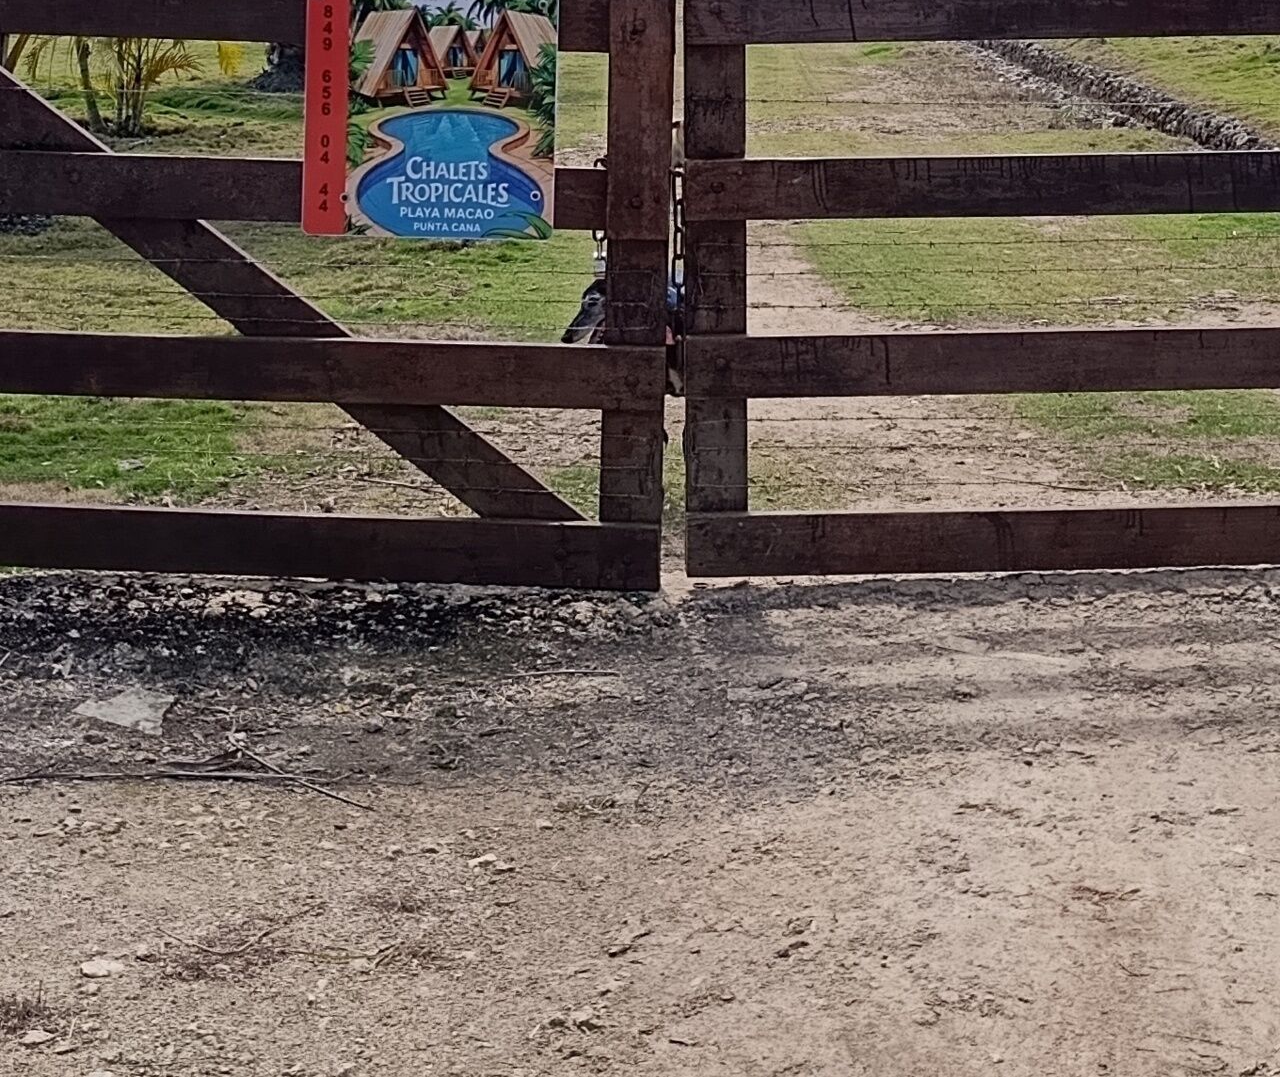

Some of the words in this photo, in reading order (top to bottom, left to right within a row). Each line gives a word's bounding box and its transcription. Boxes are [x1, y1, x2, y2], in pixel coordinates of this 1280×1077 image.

[322, 4, 334, 52] 849
[321, 70, 332, 116] 656
[319, 134, 330, 165] 04
[406, 156, 488, 180] CHALETS
[318, 182, 329, 213] 44
[386, 176, 510, 207] TROPICALES
[399, 206, 441, 219] PLAYA
[444, 208, 495, 220] MACAO
[413, 221, 449, 232] PUNTA
[451, 222, 481, 233] CANA
